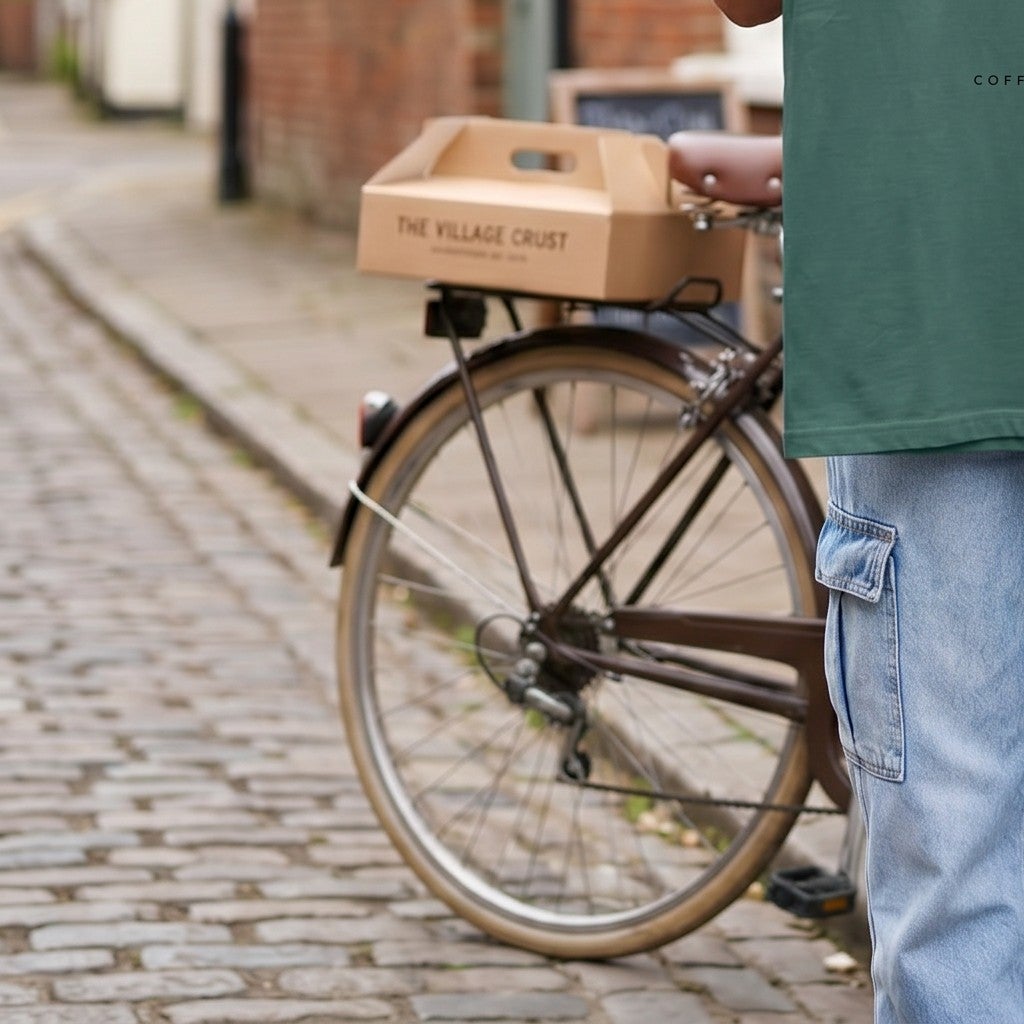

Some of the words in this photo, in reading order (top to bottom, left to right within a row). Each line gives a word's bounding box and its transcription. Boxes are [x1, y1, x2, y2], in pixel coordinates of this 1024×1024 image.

[397, 215, 429, 238] THE
[435, 220, 505, 246] VILLAGE
[510, 228, 568, 252] CRUST
